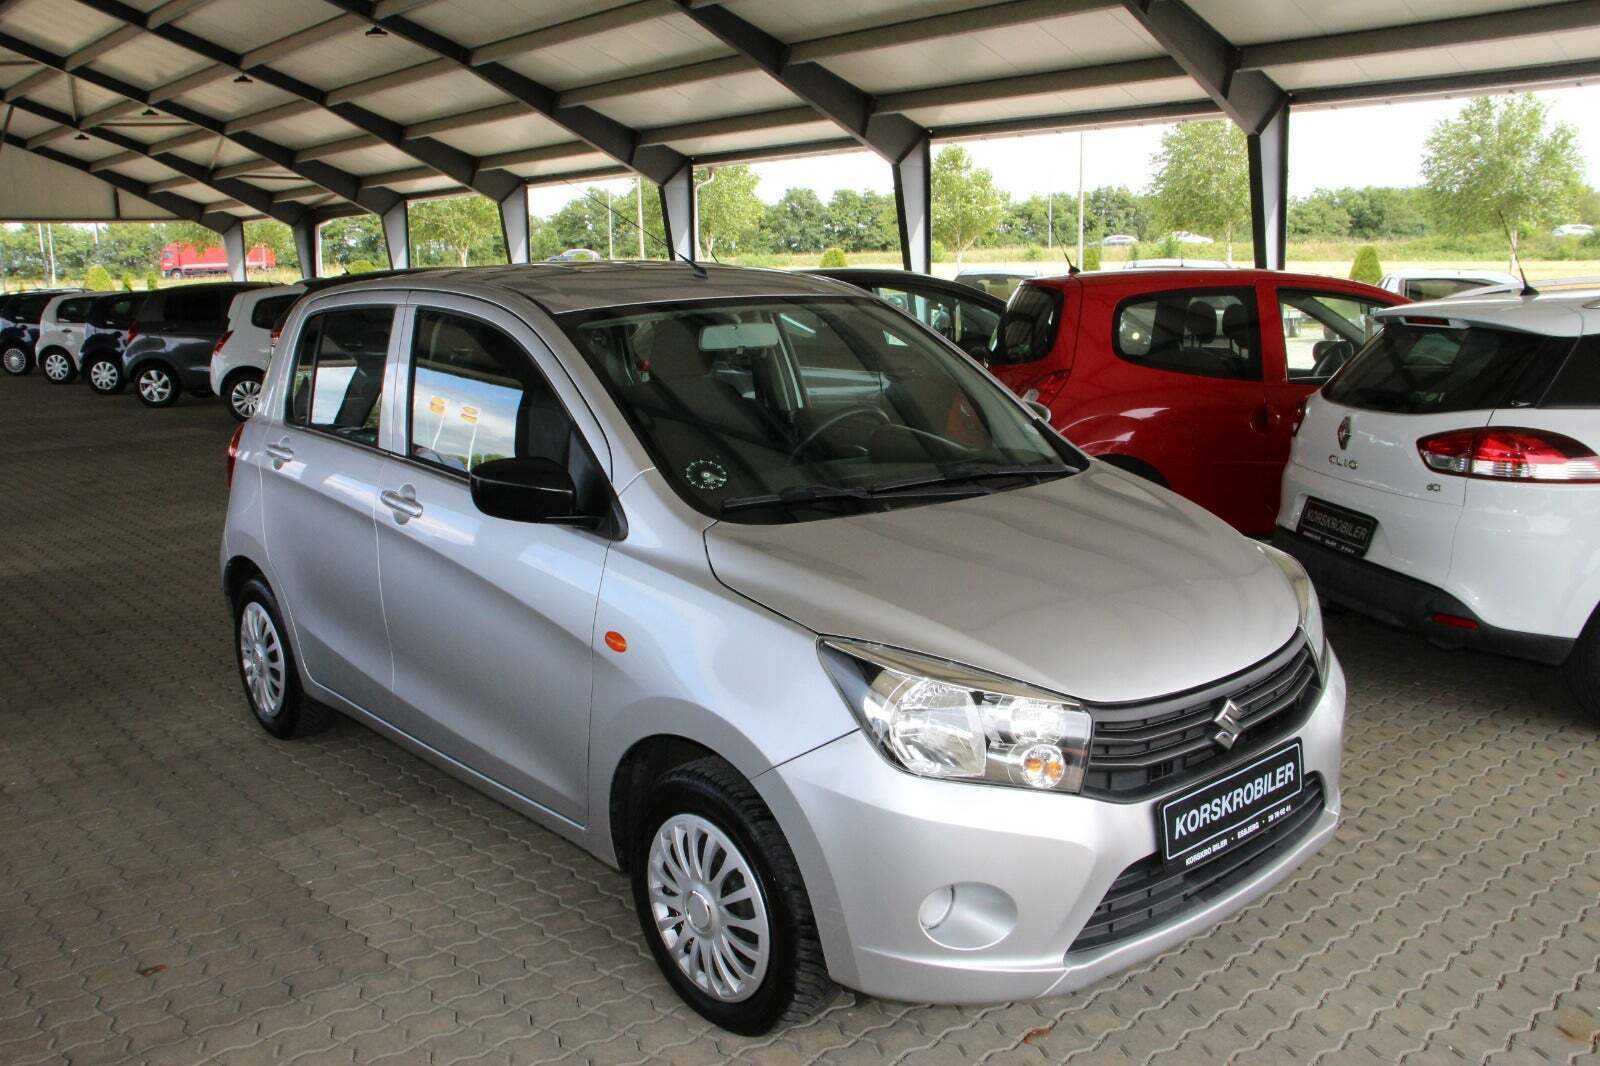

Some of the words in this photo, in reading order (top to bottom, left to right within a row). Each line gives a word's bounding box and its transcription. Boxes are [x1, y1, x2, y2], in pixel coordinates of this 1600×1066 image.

[1328, 454, 1358, 470] CLIO
[1174, 761, 1295, 840] KORSKROBILER
[1185, 847, 1212, 866] KORSKRO
[1212, 838, 1228, 853] BILER
